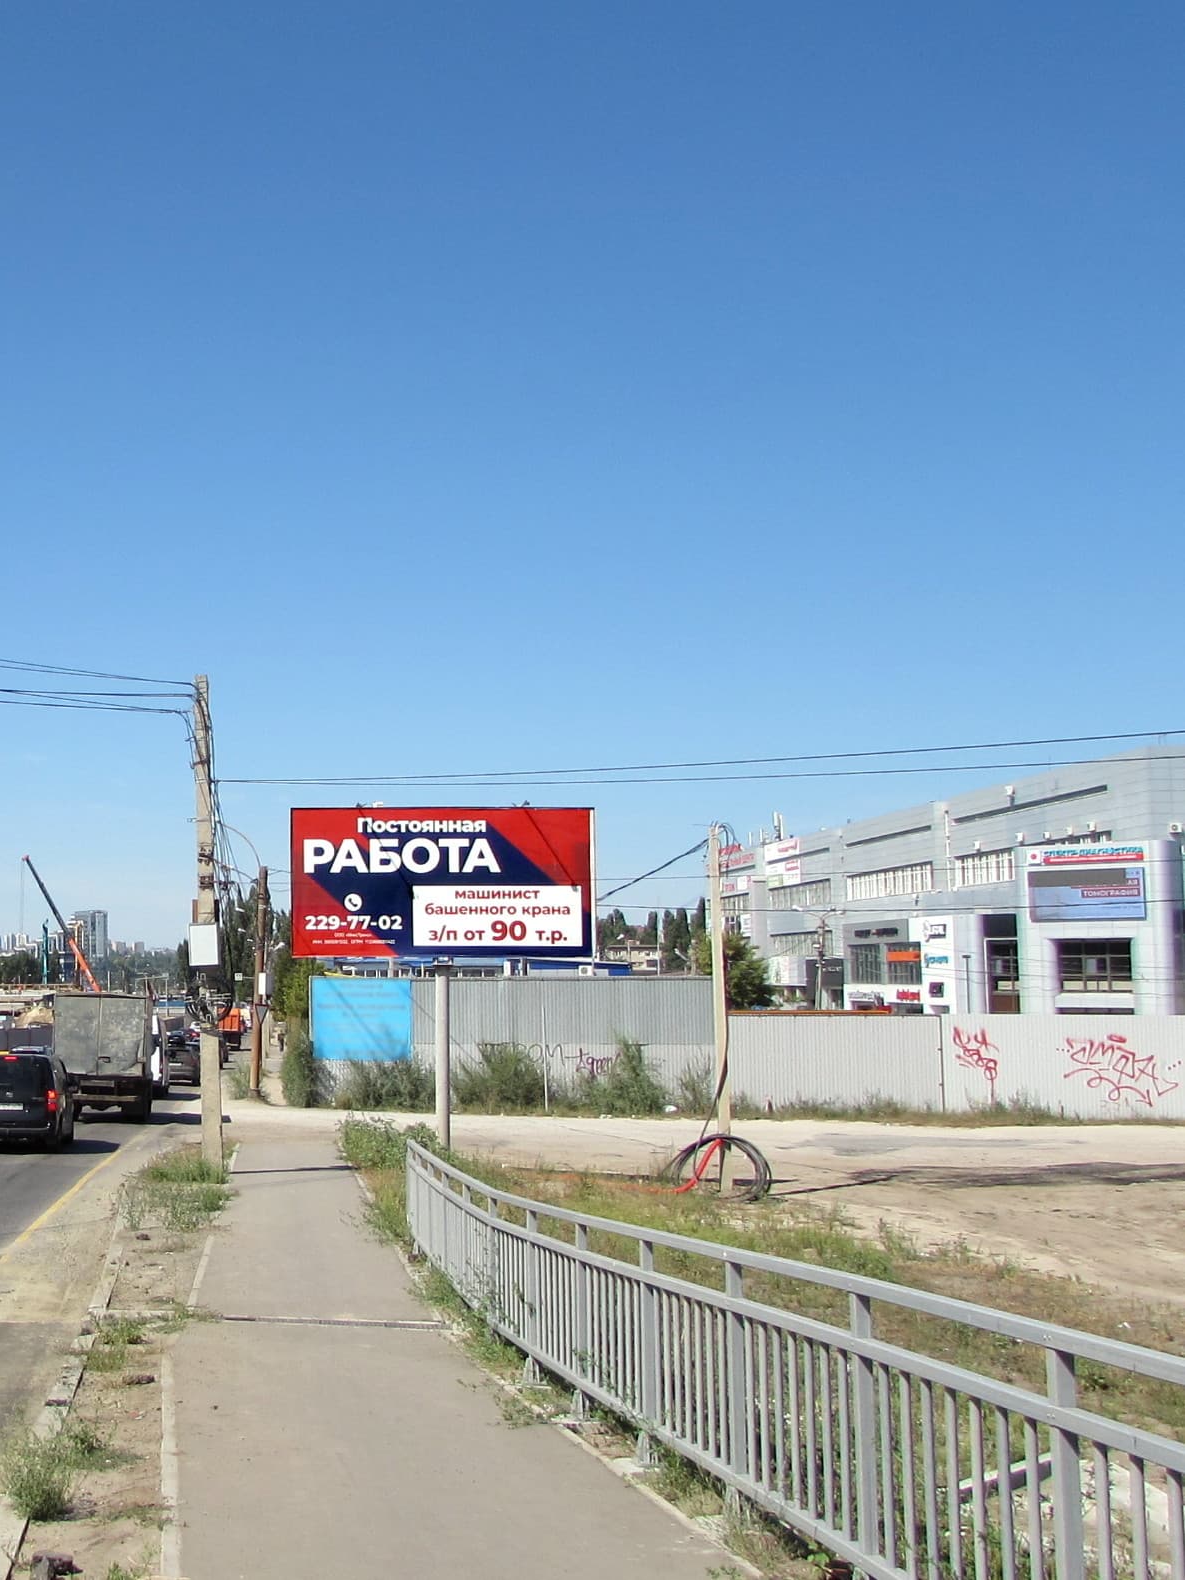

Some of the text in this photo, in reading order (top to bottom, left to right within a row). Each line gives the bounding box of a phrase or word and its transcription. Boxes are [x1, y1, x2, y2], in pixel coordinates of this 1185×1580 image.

[357, 817, 487, 833] Постоянная
[303, 838, 501, 874] РАБОТА
[454, 889, 540, 900] машинист
[424, 903, 571, 916] башенного крана
[304, 914, 403, 930] 229-77-02
[428, 920, 568, 943] з/п от 90 т.р.
